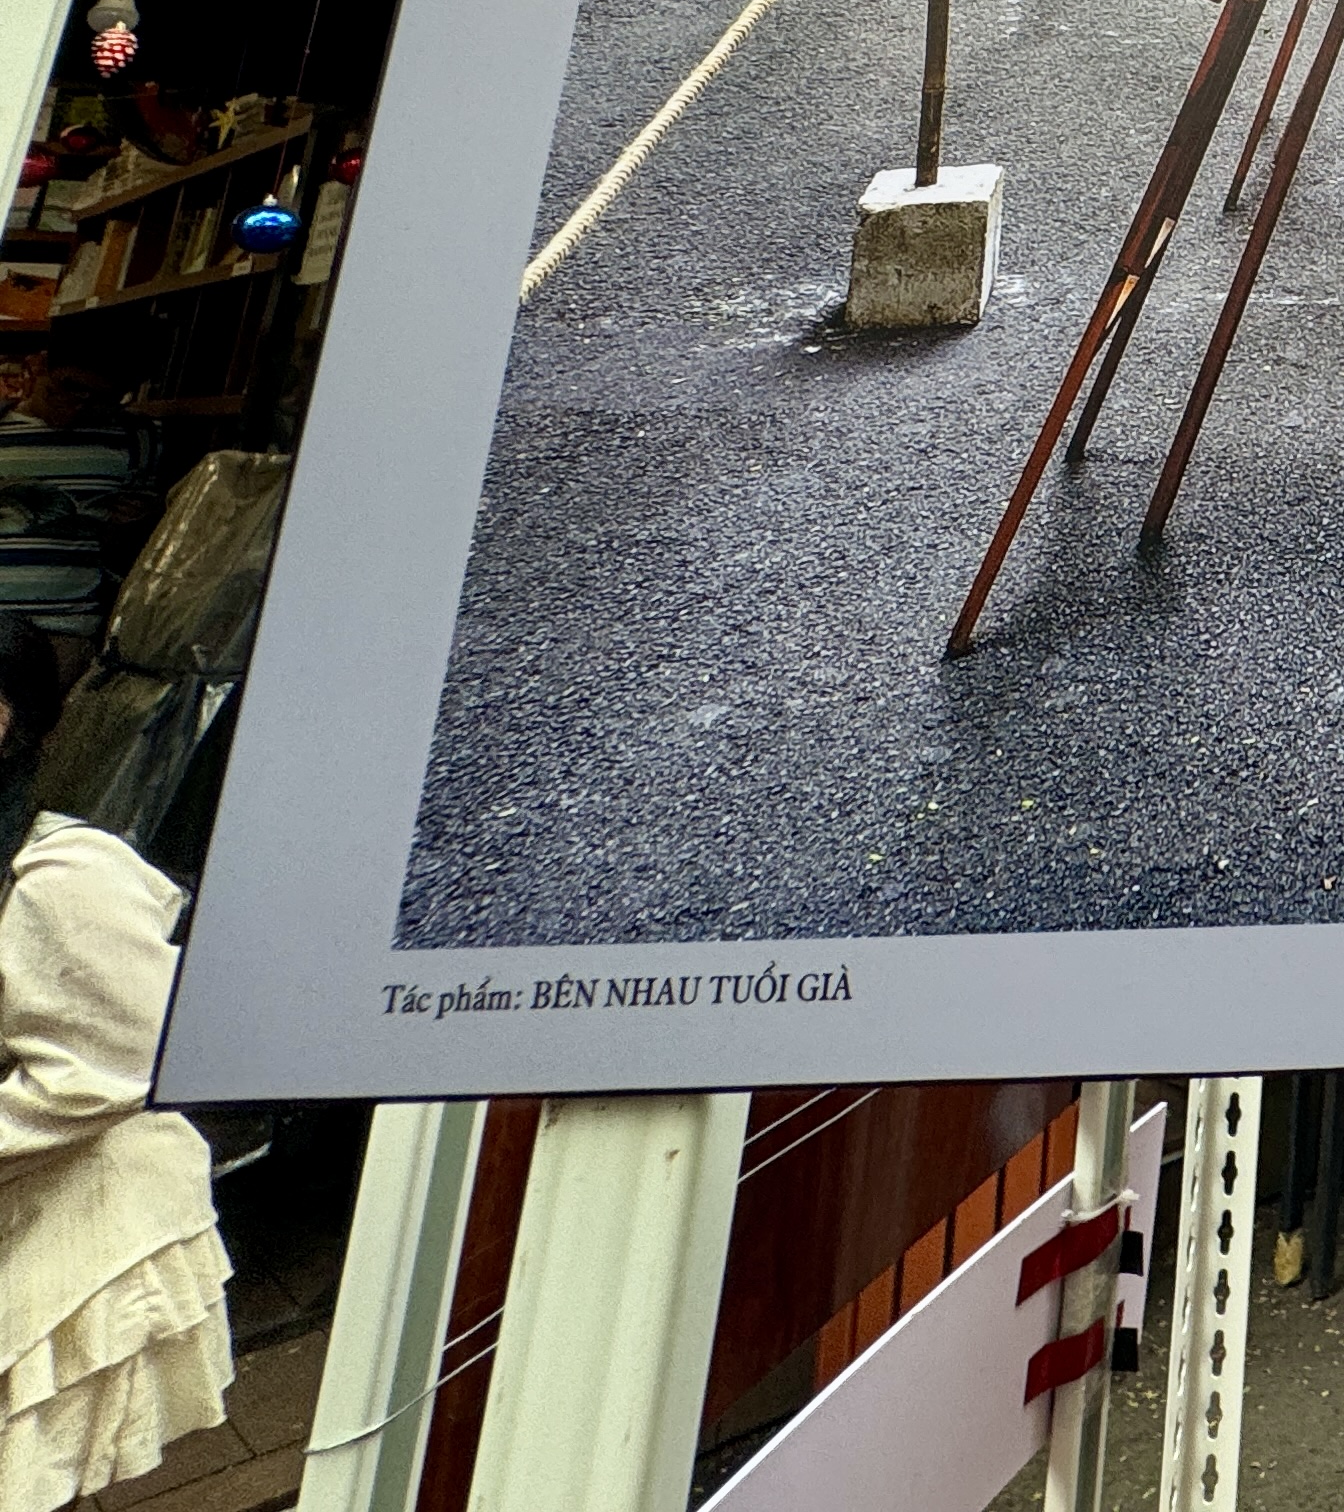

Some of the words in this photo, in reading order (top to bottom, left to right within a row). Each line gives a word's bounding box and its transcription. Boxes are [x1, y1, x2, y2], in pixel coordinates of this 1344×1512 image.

[382, 984, 432, 1014] Tác
[434, 975, 524, 1020] phẩm:
[530, 972, 601, 1010] BÊN
[603, 975, 702, 1008] NHAU
[709, 960, 790, 1004] TUỔI
[796, 963, 852, 1002] GIÀ
